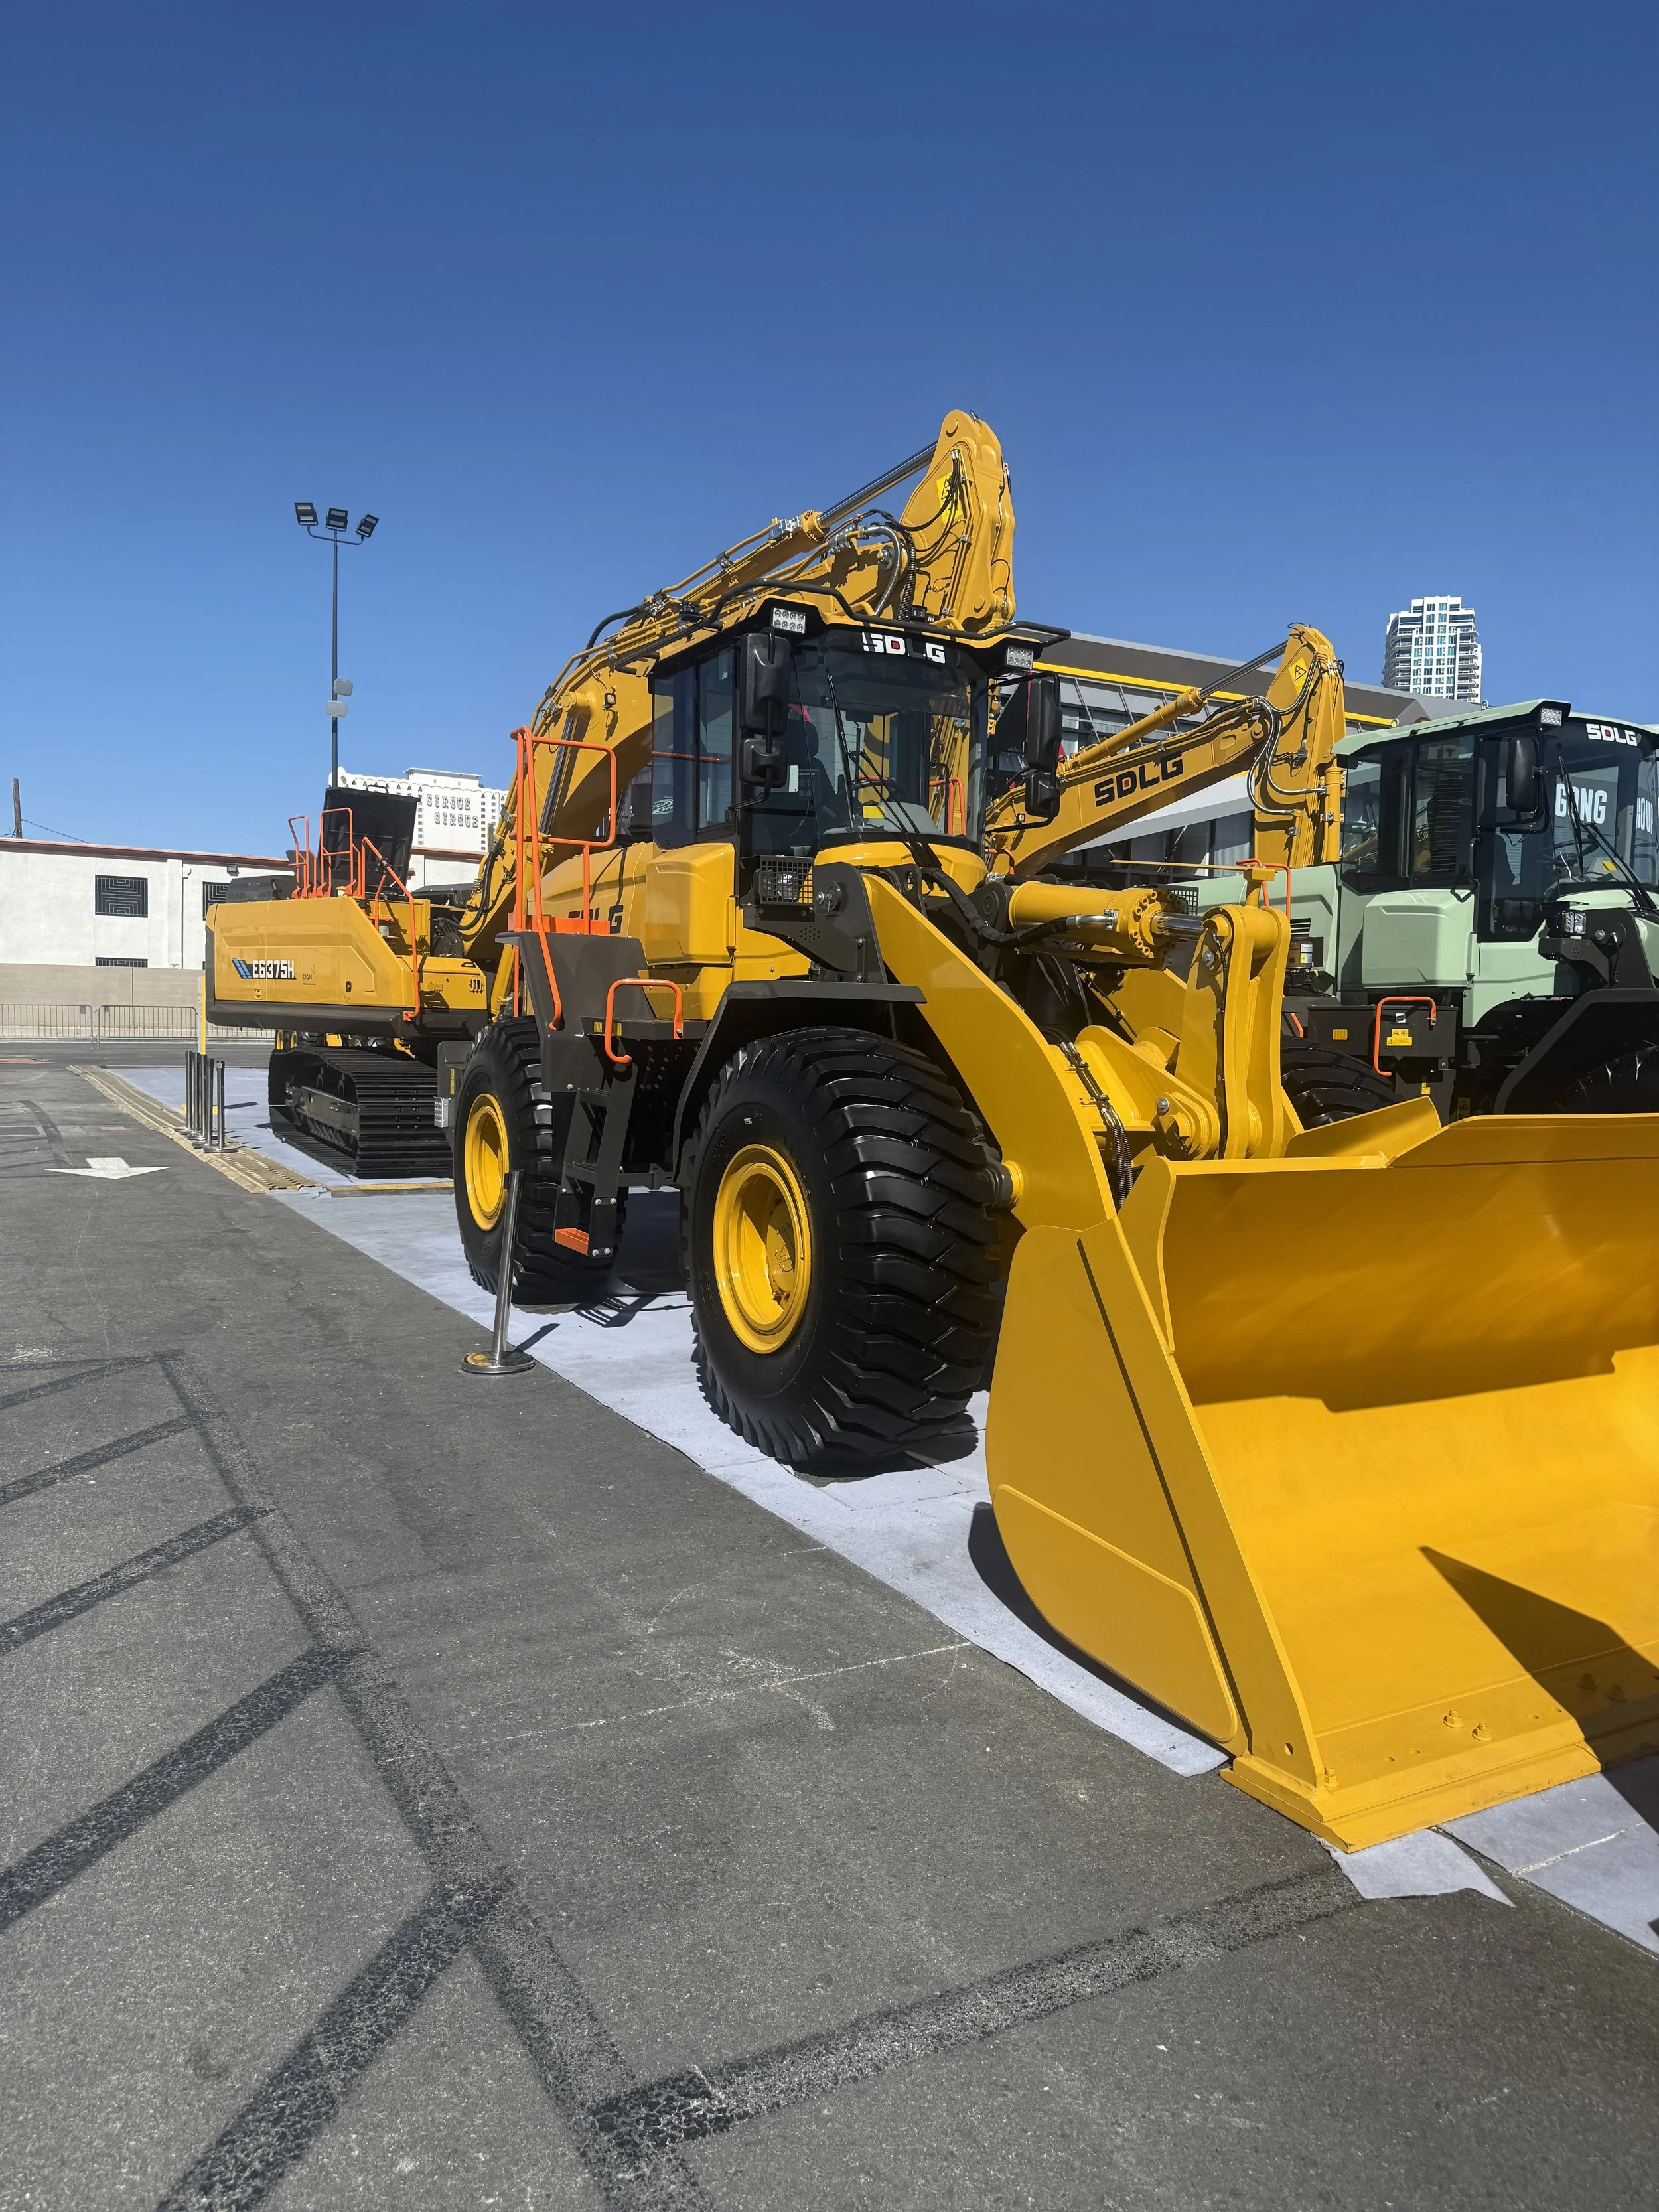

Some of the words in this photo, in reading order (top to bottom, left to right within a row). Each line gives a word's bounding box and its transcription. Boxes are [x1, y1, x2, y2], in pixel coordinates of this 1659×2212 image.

[1585, 723, 1637, 746] SDLG
[1094, 751, 1183, 807] SDLG
[427, 794, 470, 811] CIRCUS
[435, 812, 478, 828] CIRCUS
[252, 960, 295, 978] E6375H
